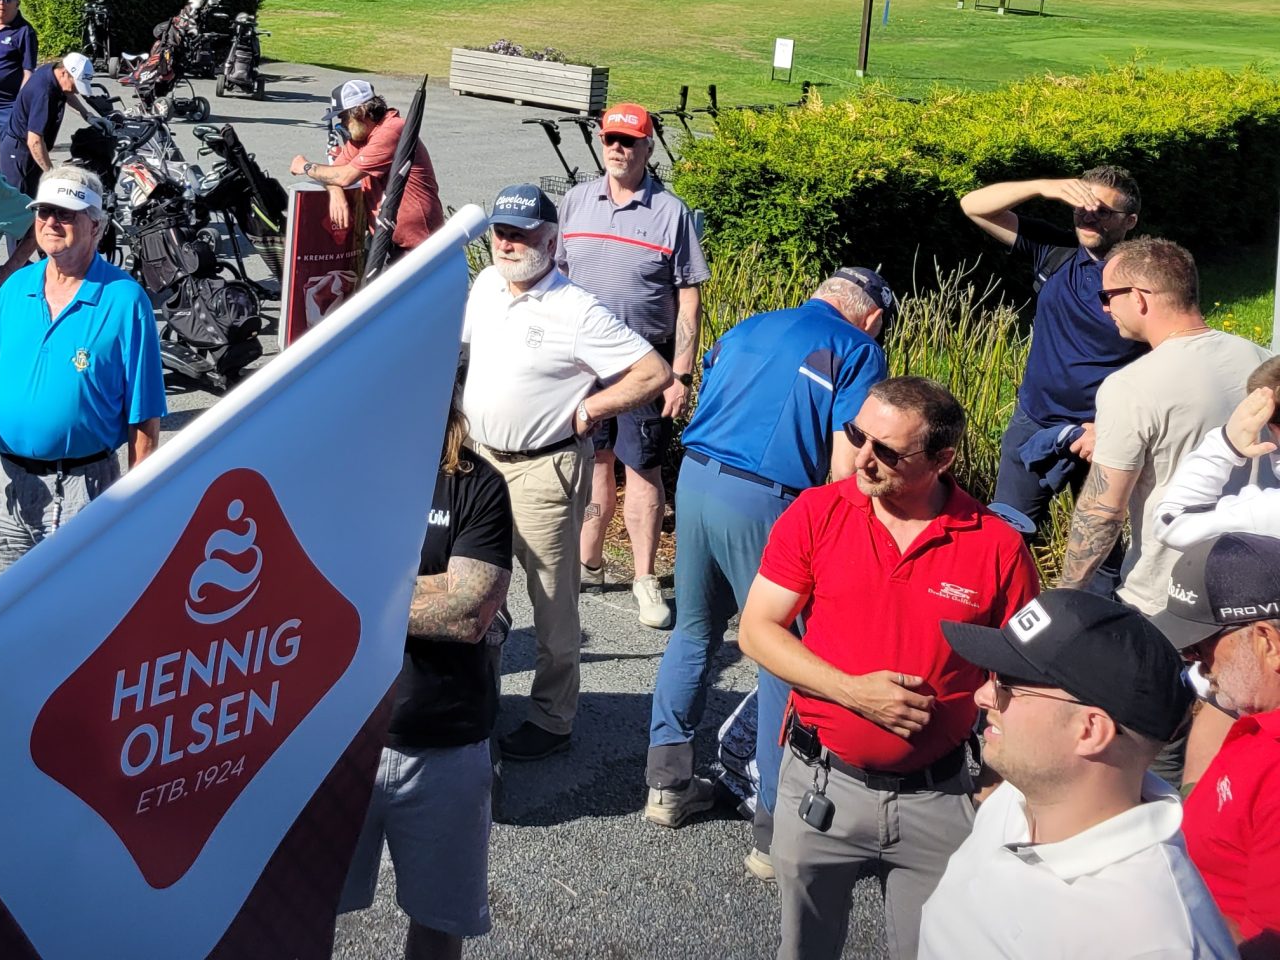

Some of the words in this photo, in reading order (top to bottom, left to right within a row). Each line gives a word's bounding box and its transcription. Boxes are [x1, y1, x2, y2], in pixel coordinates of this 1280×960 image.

[607, 113, 640, 126] PING
[57, 187, 86, 200] PING
[495, 193, 537, 207] Cleveland
[499, 203, 527, 211] GOLF
[303, 253, 334, 261] KREMEN
[1220, 606, 1258, 618] PRO
[111, 618, 303, 722] HENNIG
[120, 680, 280, 778] OLSEN
[135, 773, 189, 815] ETB.
[192, 755, 247, 796] 1924
